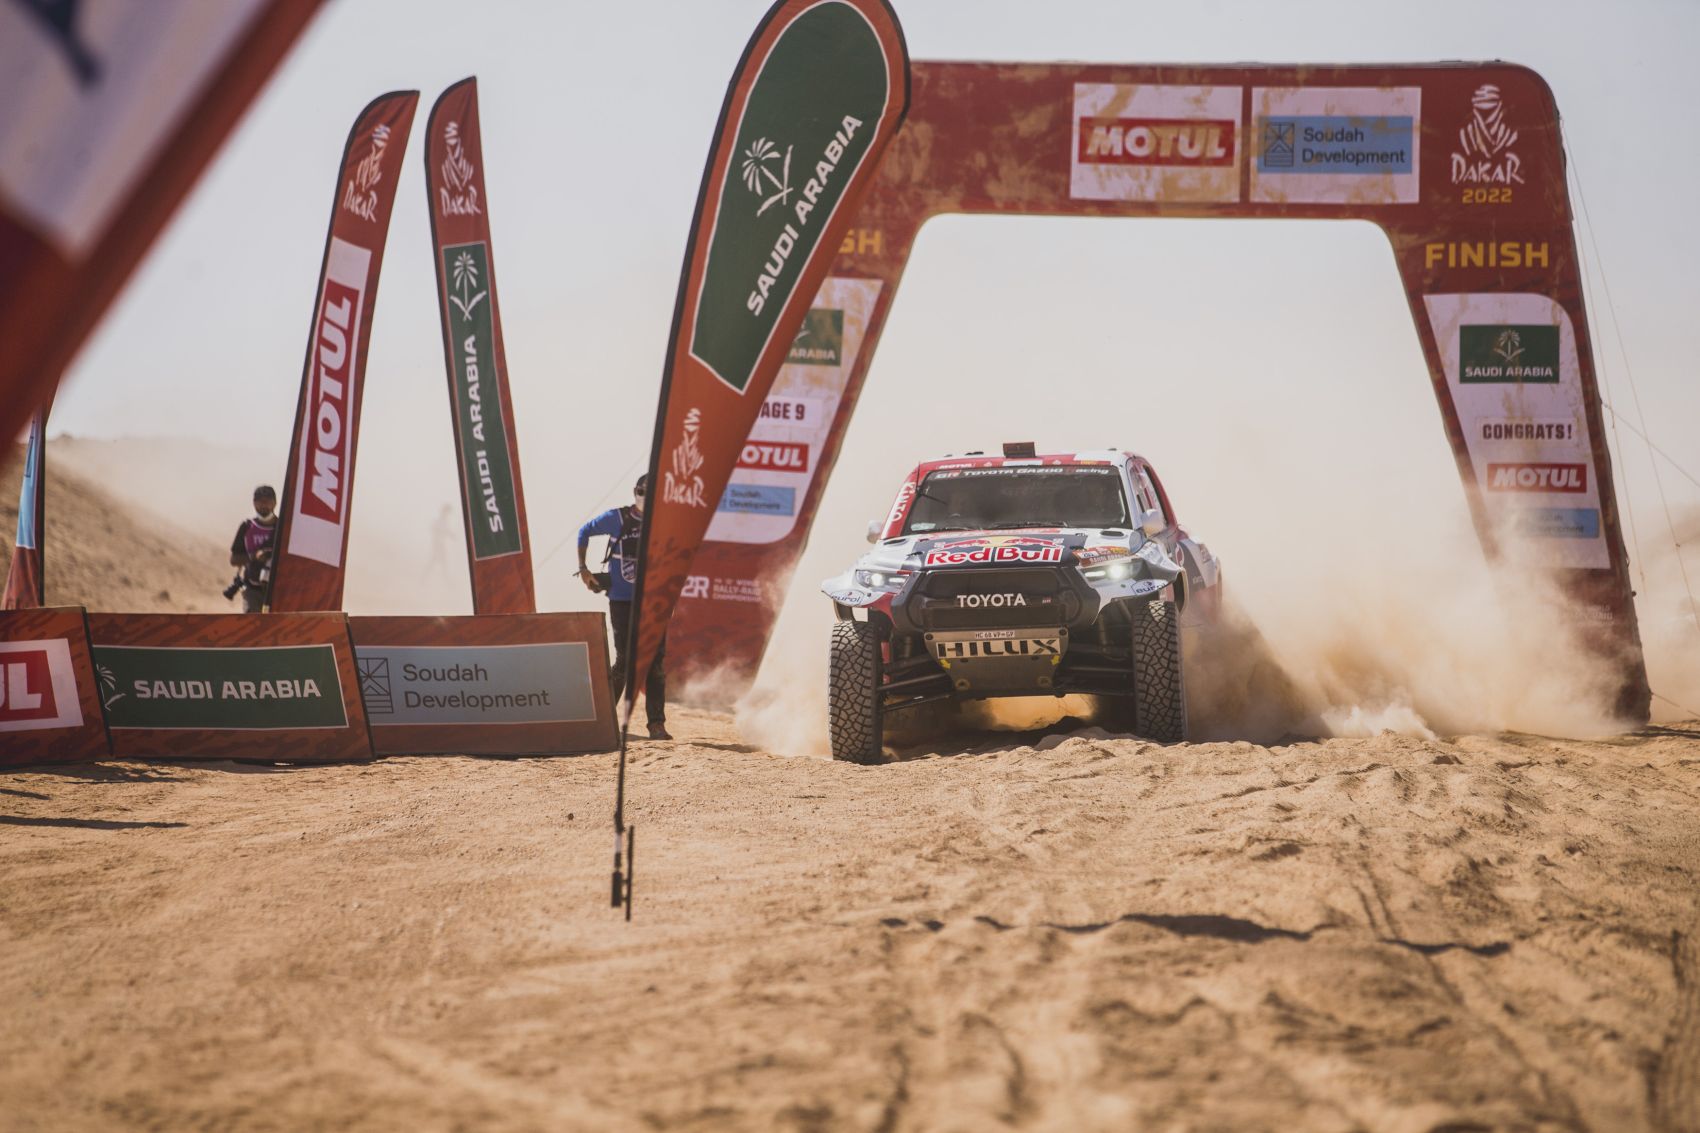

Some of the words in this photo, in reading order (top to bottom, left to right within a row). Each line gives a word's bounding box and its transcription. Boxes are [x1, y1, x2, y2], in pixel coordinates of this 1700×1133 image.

[1086, 126, 1226, 159] MOTUL
[1303, 127, 1364, 143] Soudah
[1302, 148, 1405, 166] Development
[1451, 152, 1525, 185] DAKAR
[440, 185, 481, 217] DAKAR
[1462, 188, 1512, 203] 2022
[746, 223, 799, 317] SAUDI
[796, 113, 864, 225] ARABIA
[1425, 240, 1549, 268] FINISH
[1465, 366, 1502, 377] SAUDI
[1506, 366, 1553, 377] ARABIA
[464, 334, 485, 442] ARABIA
[311, 296, 352, 513] MOTUL
[795, 403, 805, 421] 9
[1483, 423, 1572, 440] CONGRATS!
[740, 444, 803, 467] OTUL
[1066, 467, 1109, 475] acing
[1492, 467, 1581, 488] MOTUL
[476, 449, 504, 533] SAUDI
[663, 471, 708, 507] DAKAR
[926, 547, 991, 566] Red
[996, 546, 1063, 562] Bull
[957, 592, 1027, 608] TOYOTA
[938, 639, 1058, 657] HILUX
[403, 663, 488, 682] Soudah
[0, 662, 42, 711] L
[134, 680, 213, 700] SAUDI
[221, 679, 322, 700] ARABIA
[404, 690, 551, 712] Development
